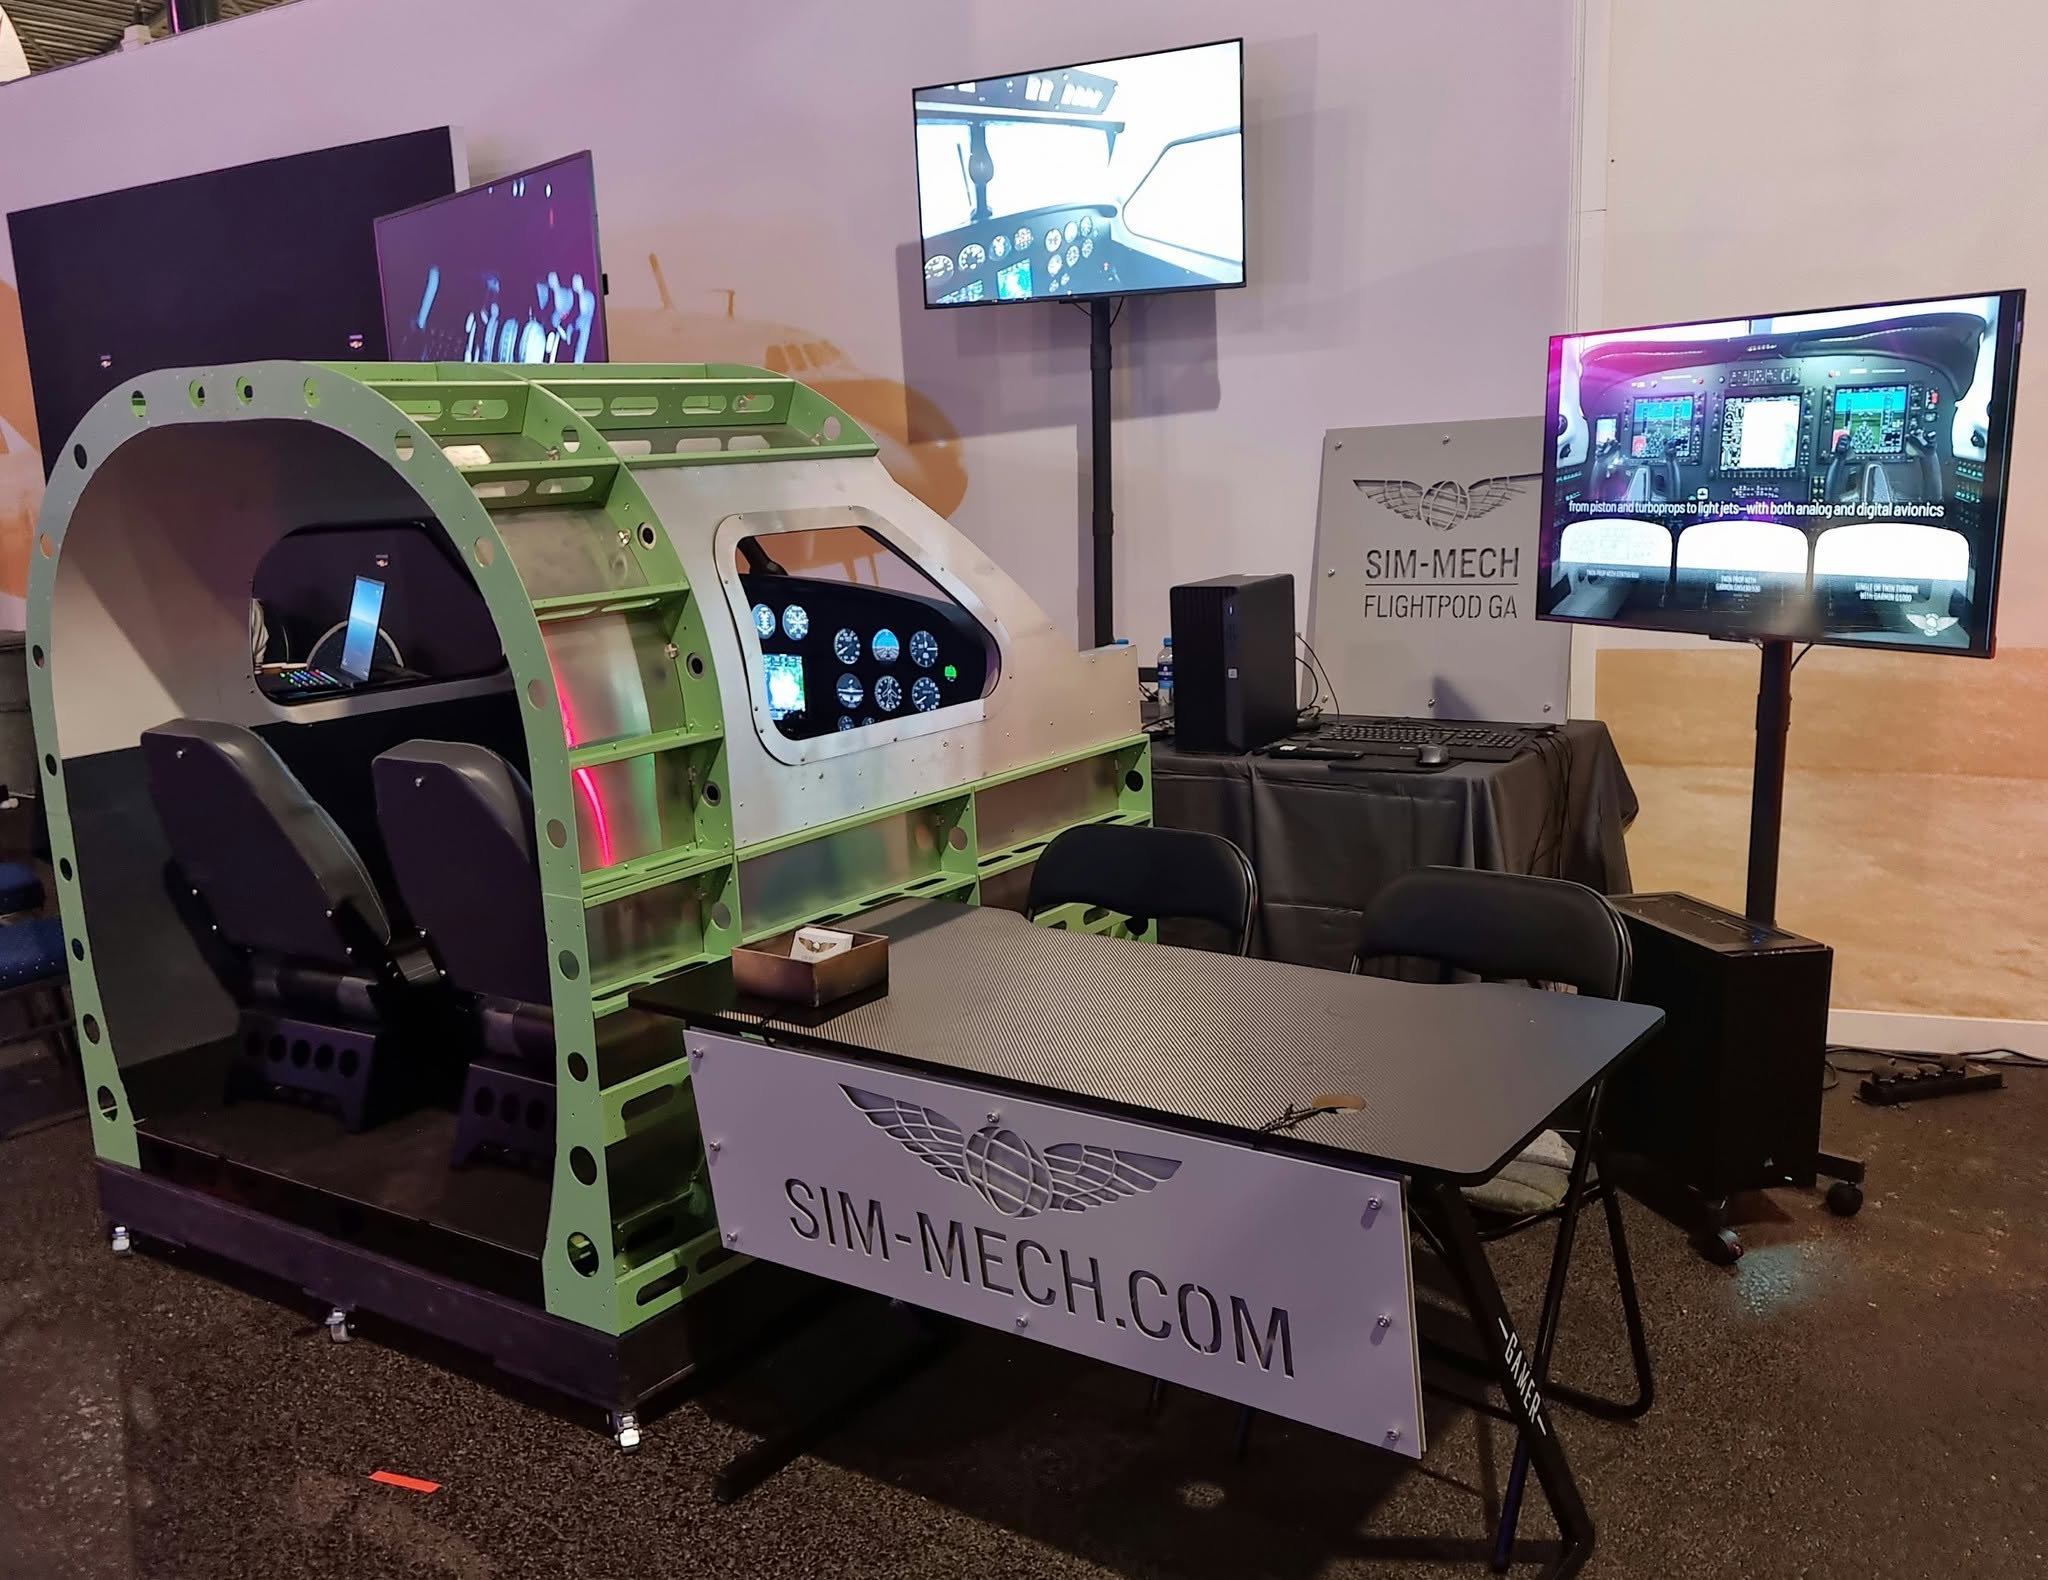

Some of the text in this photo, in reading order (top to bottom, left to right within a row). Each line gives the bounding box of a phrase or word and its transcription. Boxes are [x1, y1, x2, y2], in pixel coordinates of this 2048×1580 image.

[1568, 501, 1589, 513] from
[1590, 501, 1617, 515] piston
[1618, 501, 1634, 513] and
[1635, 501, 1685, 516] turboprops
[1687, 502, 1697, 514] to
[1698, 501, 1719, 517] light
[1770, 502, 1795, 516] both
[1797, 502, 1832, 519] analog
[1834, 503, 1854, 517] and
[1857, 502, 1892, 519] digital
[1893, 502, 1945, 517] avionics
[1365, 547, 1520, 580] SIM-MECH
[1364, 594, 1518, 620] FLIGHTPOD GA
[784, 1176, 1296, 1379] SIM-MECH.COM
